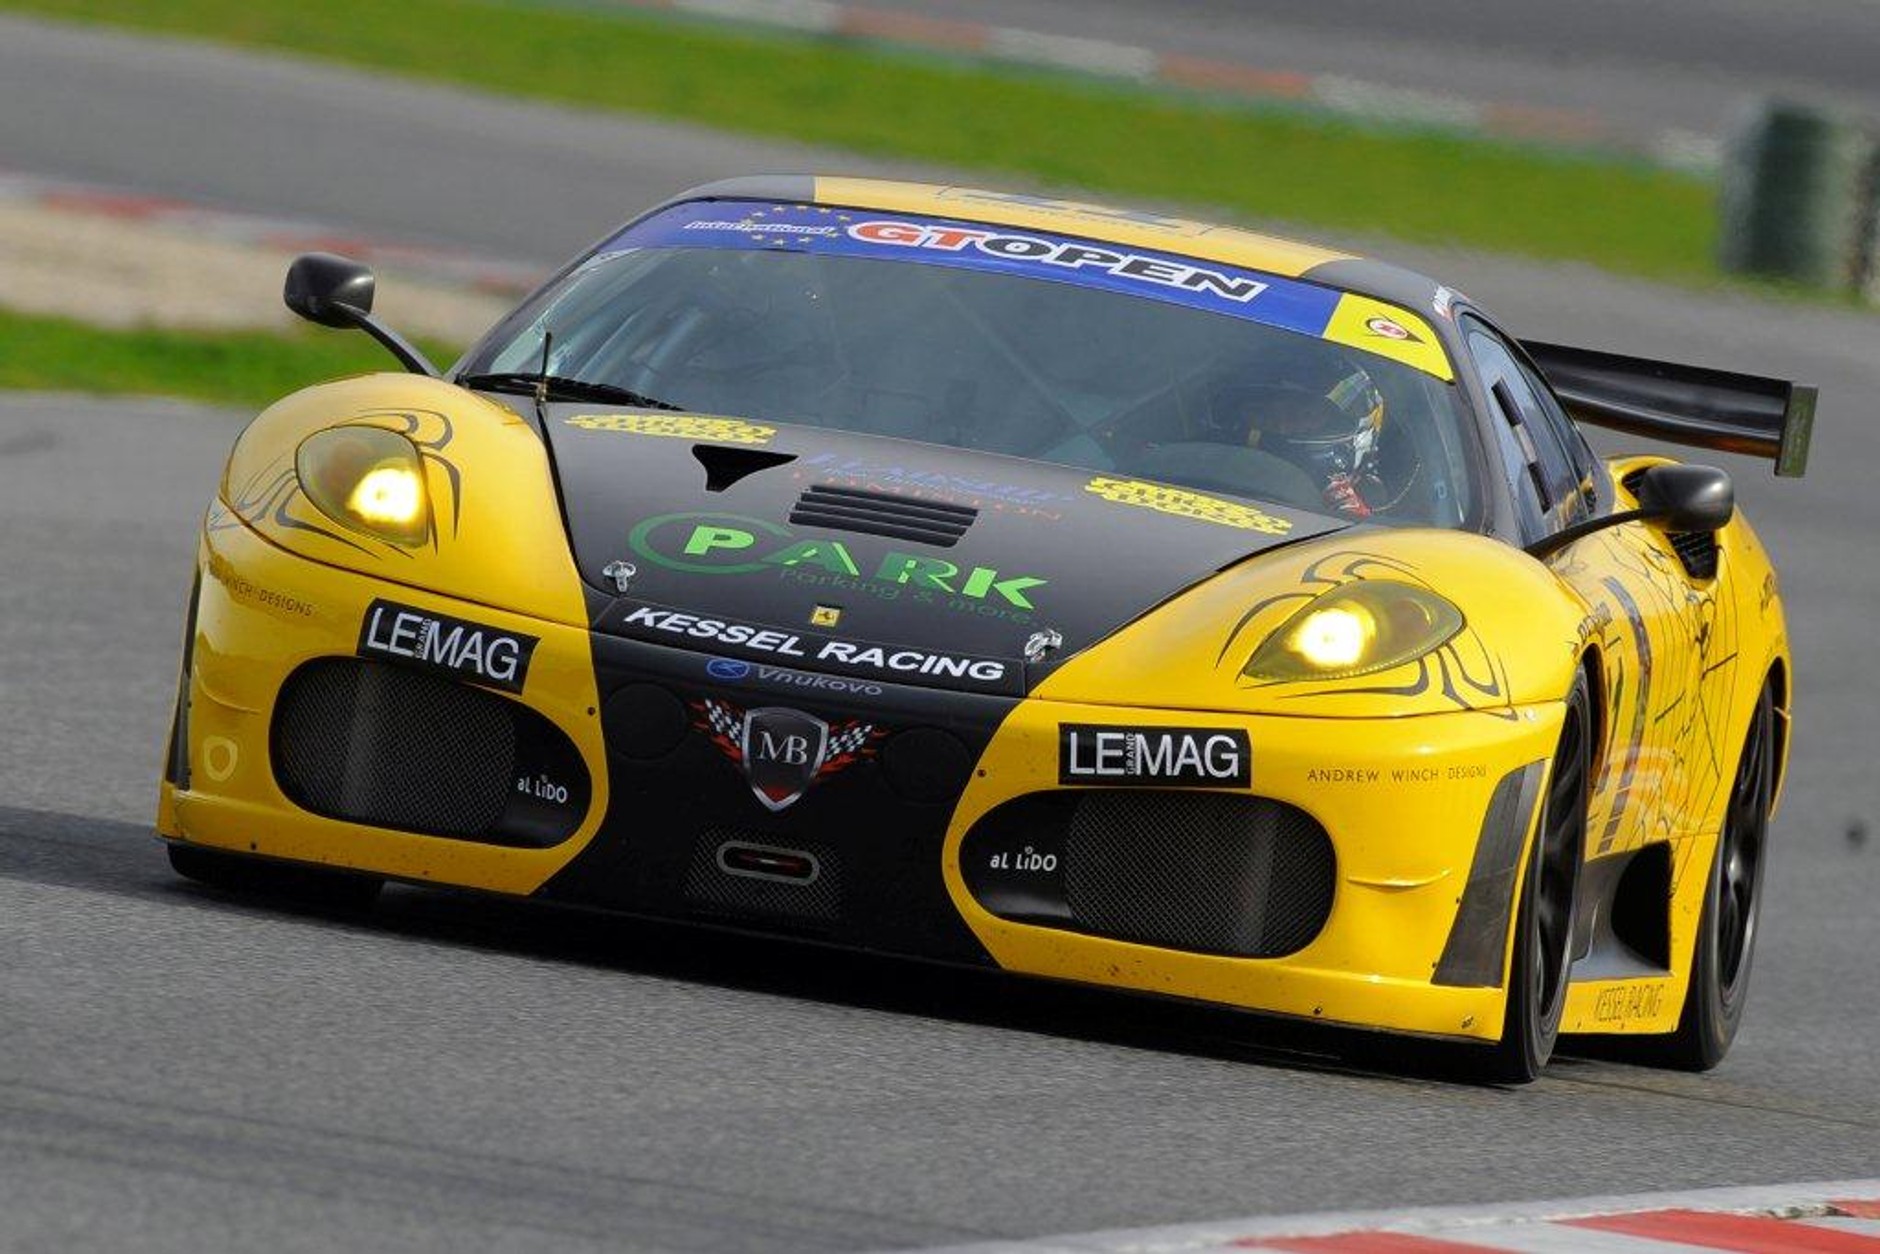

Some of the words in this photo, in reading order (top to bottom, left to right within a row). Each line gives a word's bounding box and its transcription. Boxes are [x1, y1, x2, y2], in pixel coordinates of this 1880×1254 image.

[684, 525, 1048, 610] PARK
[258, 588, 314, 617] DESIGNS
[624, 607, 805, 657] KESSEL
[817, 641, 1005, 681] RACING
[757, 730, 808, 765] MB
[1306, 767, 1380, 783] ANDREW
[1390, 767, 1438, 782] WINCH
